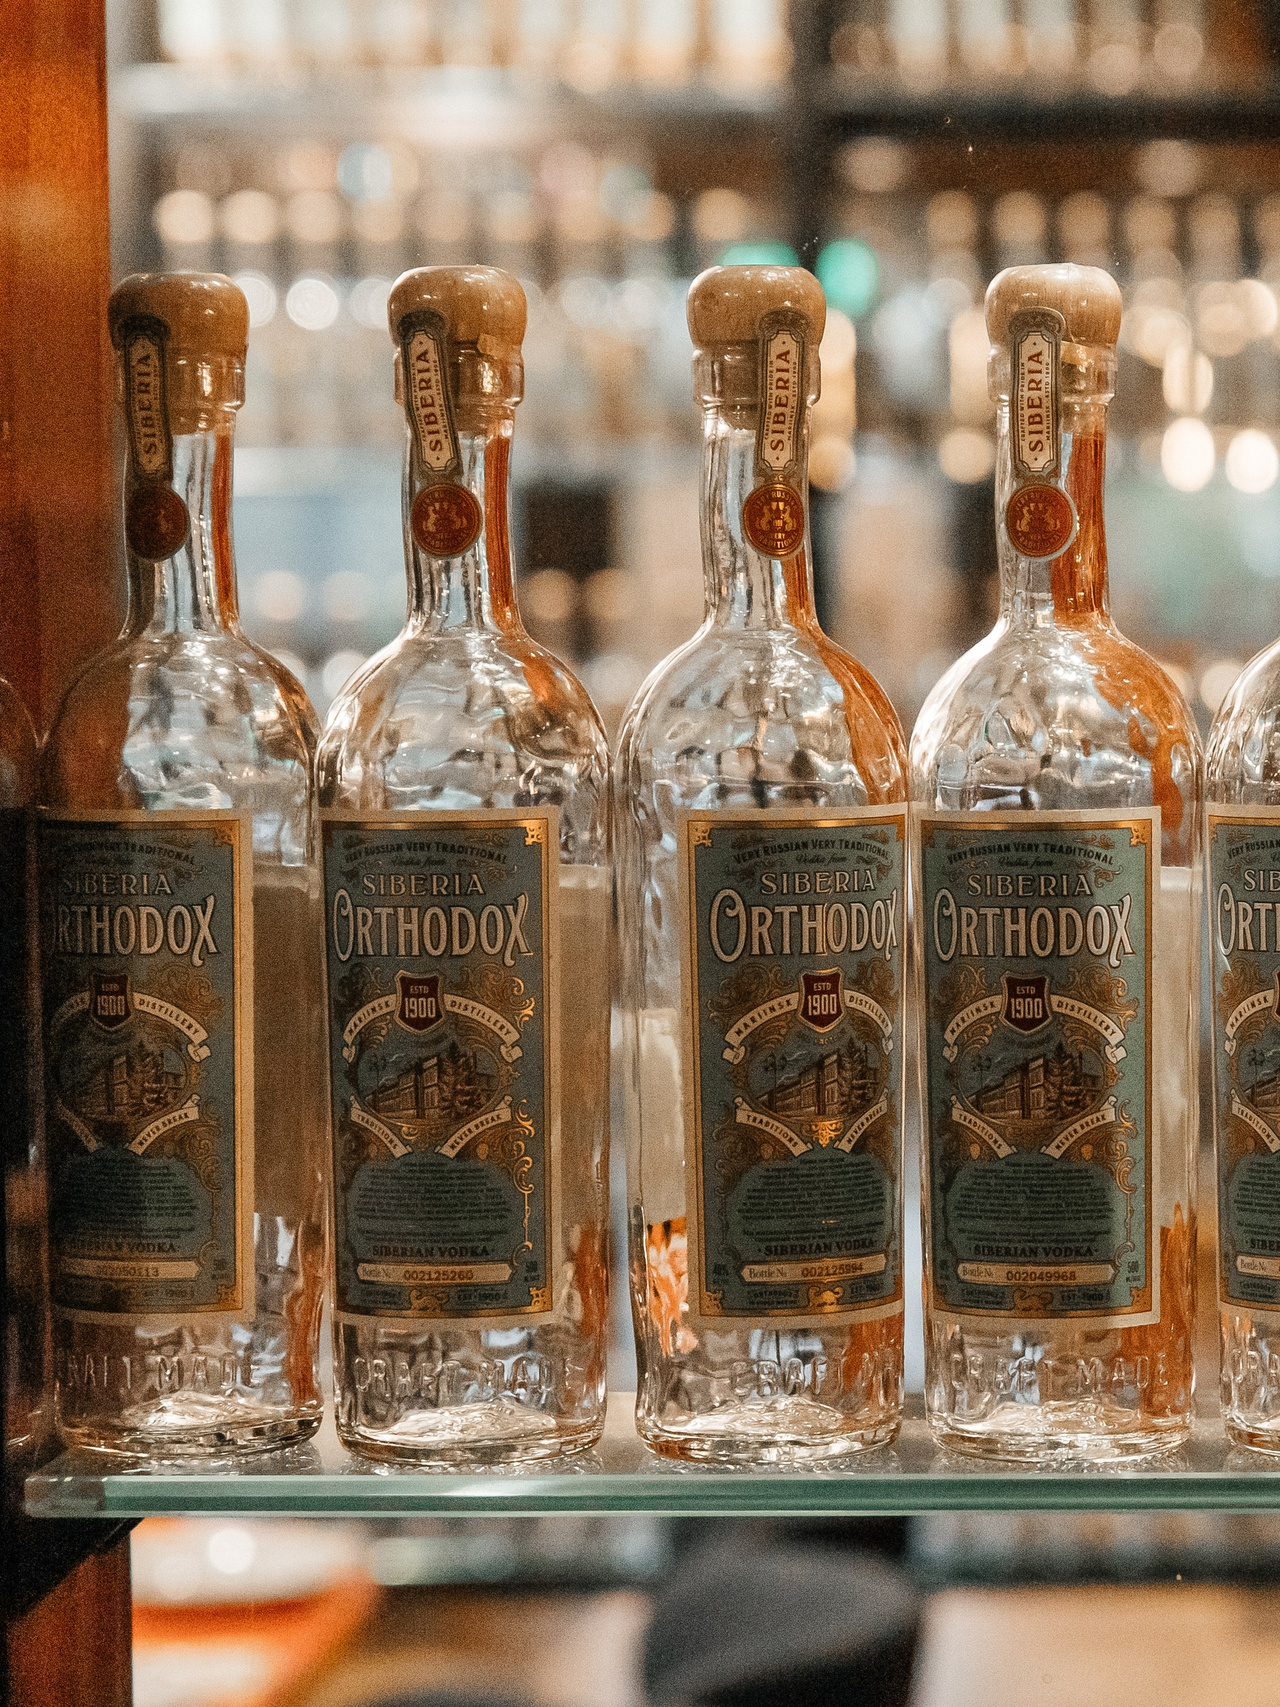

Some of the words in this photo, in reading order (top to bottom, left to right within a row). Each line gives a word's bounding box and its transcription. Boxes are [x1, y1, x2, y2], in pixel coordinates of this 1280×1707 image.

[137, 355, 156, 455] SIBERIA
[416, 349, 442, 451] SIBERIA
[770, 349, 790, 451] SIBERIA
[1027, 350, 1043, 451] SIBERIA
[406, 841, 432, 851] VERY
[434, 842, 508, 864] TRADITIONAL
[733, 851, 761, 865] VERY
[764, 842, 808, 856] RUSSIAN
[811, 839, 835, 849] VERY
[839, 839, 889, 859] TRADITIONAL
[947, 851, 967, 864] VERY
[970, 844, 1011, 856] RUSSIAN
[1013, 842, 1040, 853] VERY
[1042, 843, 1113, 865] TRADITIONAL
[1227, 846, 1244, 860] VERY
[65, 873, 173, 895] SIBERIA
[363, 873, 484, 896] SIBERIA
[761, 870, 876, 895] SIBERIA
[968, 874, 1093, 896] SIBERIA
[334, 889, 533, 966] ORTHODOX
[710, 889, 899, 963] ORTHODOX
[934, 889, 1135, 968] ORTHODOX
[410, 986, 428, 994] ESTD
[1017, 986, 1035, 994] ESTD
[97, 995, 125, 1015] 1900
[138, 999, 200, 1035] DISTILLERY
[405, 998, 436, 1018] 1900
[734, 1001, 793, 1037] MARIINSK
[848, 996, 890, 1029] DISTILLERY
[808, 994, 836, 1016] 1900
[1011, 998, 1043, 1019] 1900
[1230, 996, 1269, 1030] MARIINSK
[348, 1001, 391, 1034] MARIINSK
[451, 1001, 511, 1036] DISTILLERY
[950, 1001, 996, 1036] MARIINSK
[1057, 1001, 1117, 1037] DISTILLERY
[357, 1114, 398, 1149] TRADITIONS
[450, 1128, 471, 1151] NEVER
[474, 1114, 502, 1131] BREAK
[746, 1115, 798, 1147] TRADITIONS
[847, 1123, 865, 1144] NEVER
[959, 1115, 1002, 1149] TRADITIONS
[1055, 1128, 1079, 1150] NEVER
[1080, 1114, 1107, 1132] BREAK
[1237, 1107, 1275, 1145] TRADITIONS
[373, 1246, 433, 1257] SIBERIAN
[437, 1246, 489, 1257] VODKA
[766, 1242, 832, 1255] SIBERIAN
[836, 1239, 874, 1252] VODKA
[975, 1246, 1042, 1257] SIBERIAN
[1045, 1247, 1093, 1257] VODKA
[1006, 1271, 1076, 1282] 002049968
